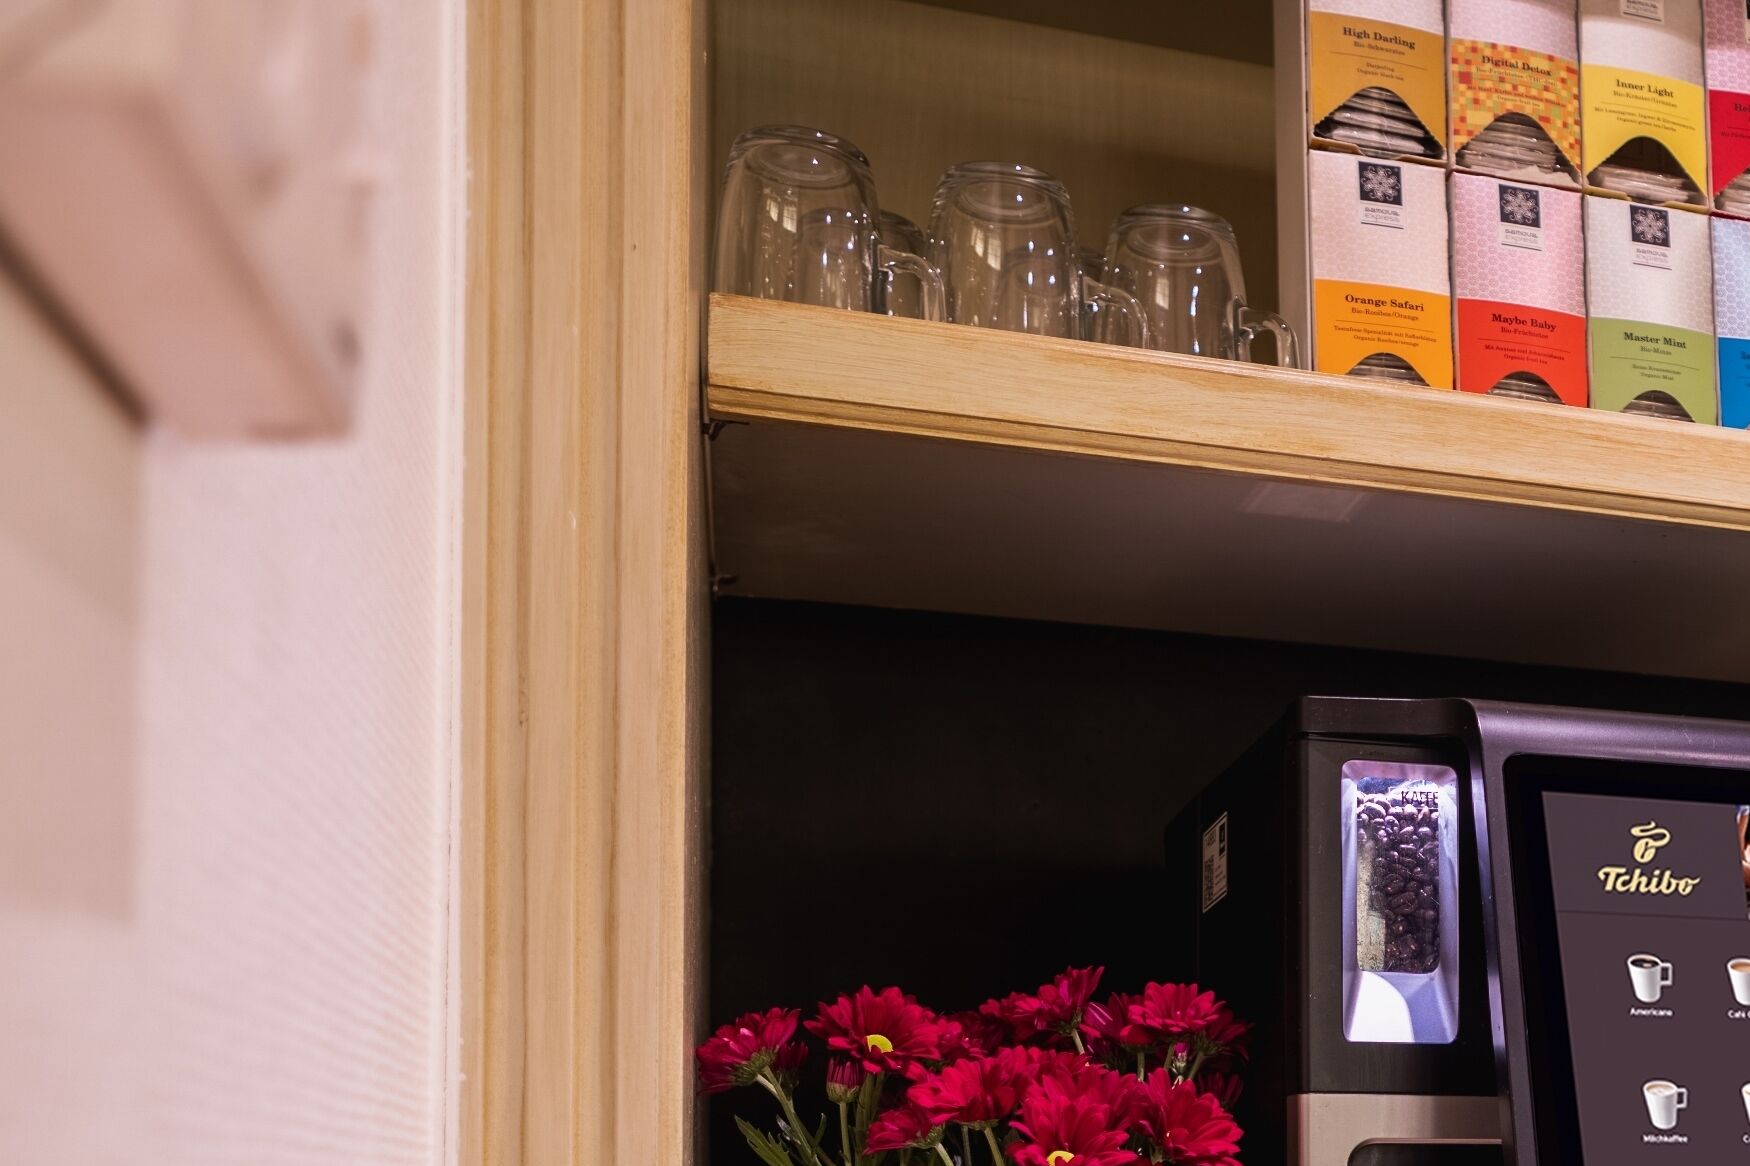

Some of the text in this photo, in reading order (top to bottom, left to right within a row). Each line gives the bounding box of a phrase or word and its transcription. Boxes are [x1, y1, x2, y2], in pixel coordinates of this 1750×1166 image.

[1342, 26, 1416, 50] High Darling
[1481, 55, 1552, 76] Digital Detox
[1616, 79, 1674, 99] Inner Light
[1345, 294, 1425, 312] Orange Safari
[1492, 313, 1557, 333] Maybe Baby
[1624, 332, 1687, 349] Master Mint
[1598, 866, 1701, 896] Tchibo
[1630, 1007, 1673, 1017] Americano
[1728, 1009, 1746, 1019] Café
[1643, 1134, 1688, 1144] Milchkaffee
